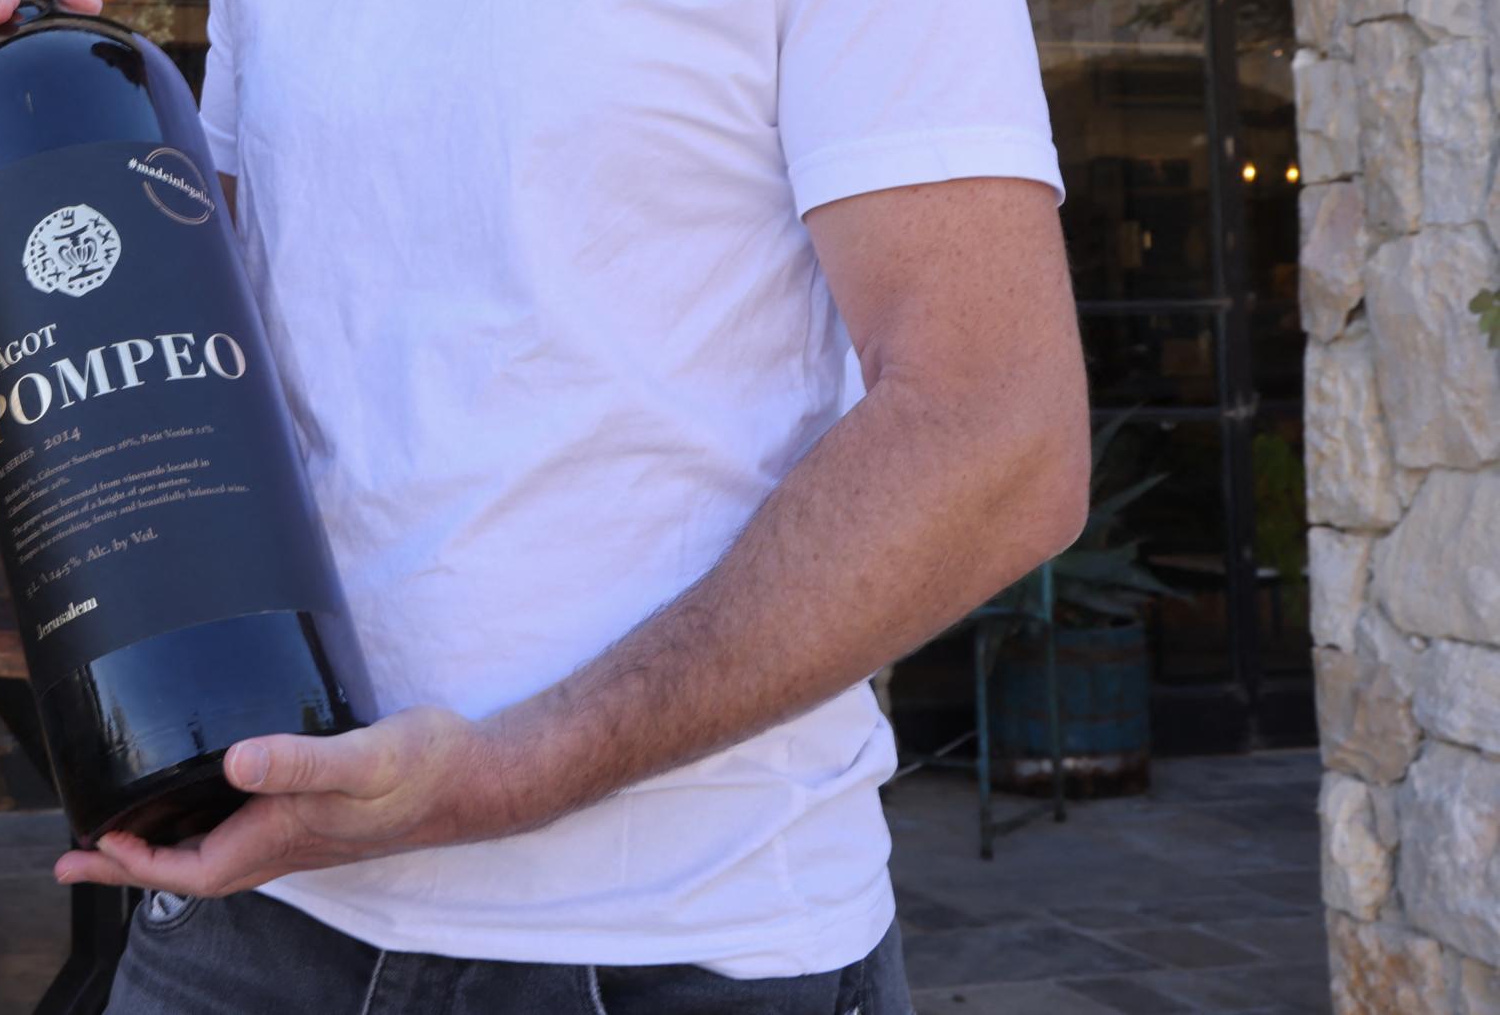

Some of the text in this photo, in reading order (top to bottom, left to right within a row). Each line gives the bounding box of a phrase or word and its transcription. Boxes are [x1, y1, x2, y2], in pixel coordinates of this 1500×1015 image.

[43, 426, 81, 451] 2014
[70, 445, 116, 465] Sauvignon
[98, 479, 121, 491] from
[121, 465, 166, 484] vineyards
[166, 457, 199, 473] located
[200, 457, 211, 467] in
[91, 510, 118, 525] fruity
[119, 500, 137, 516] and
[136, 487, 187, 509] beautifully
[186, 482, 226, 499] balanced
[97, 490, 126, 506] height
[85, 543, 112, 563] Alc.
[110, 536, 130, 554] by
[36, 597, 98, 641] Jerusalem
